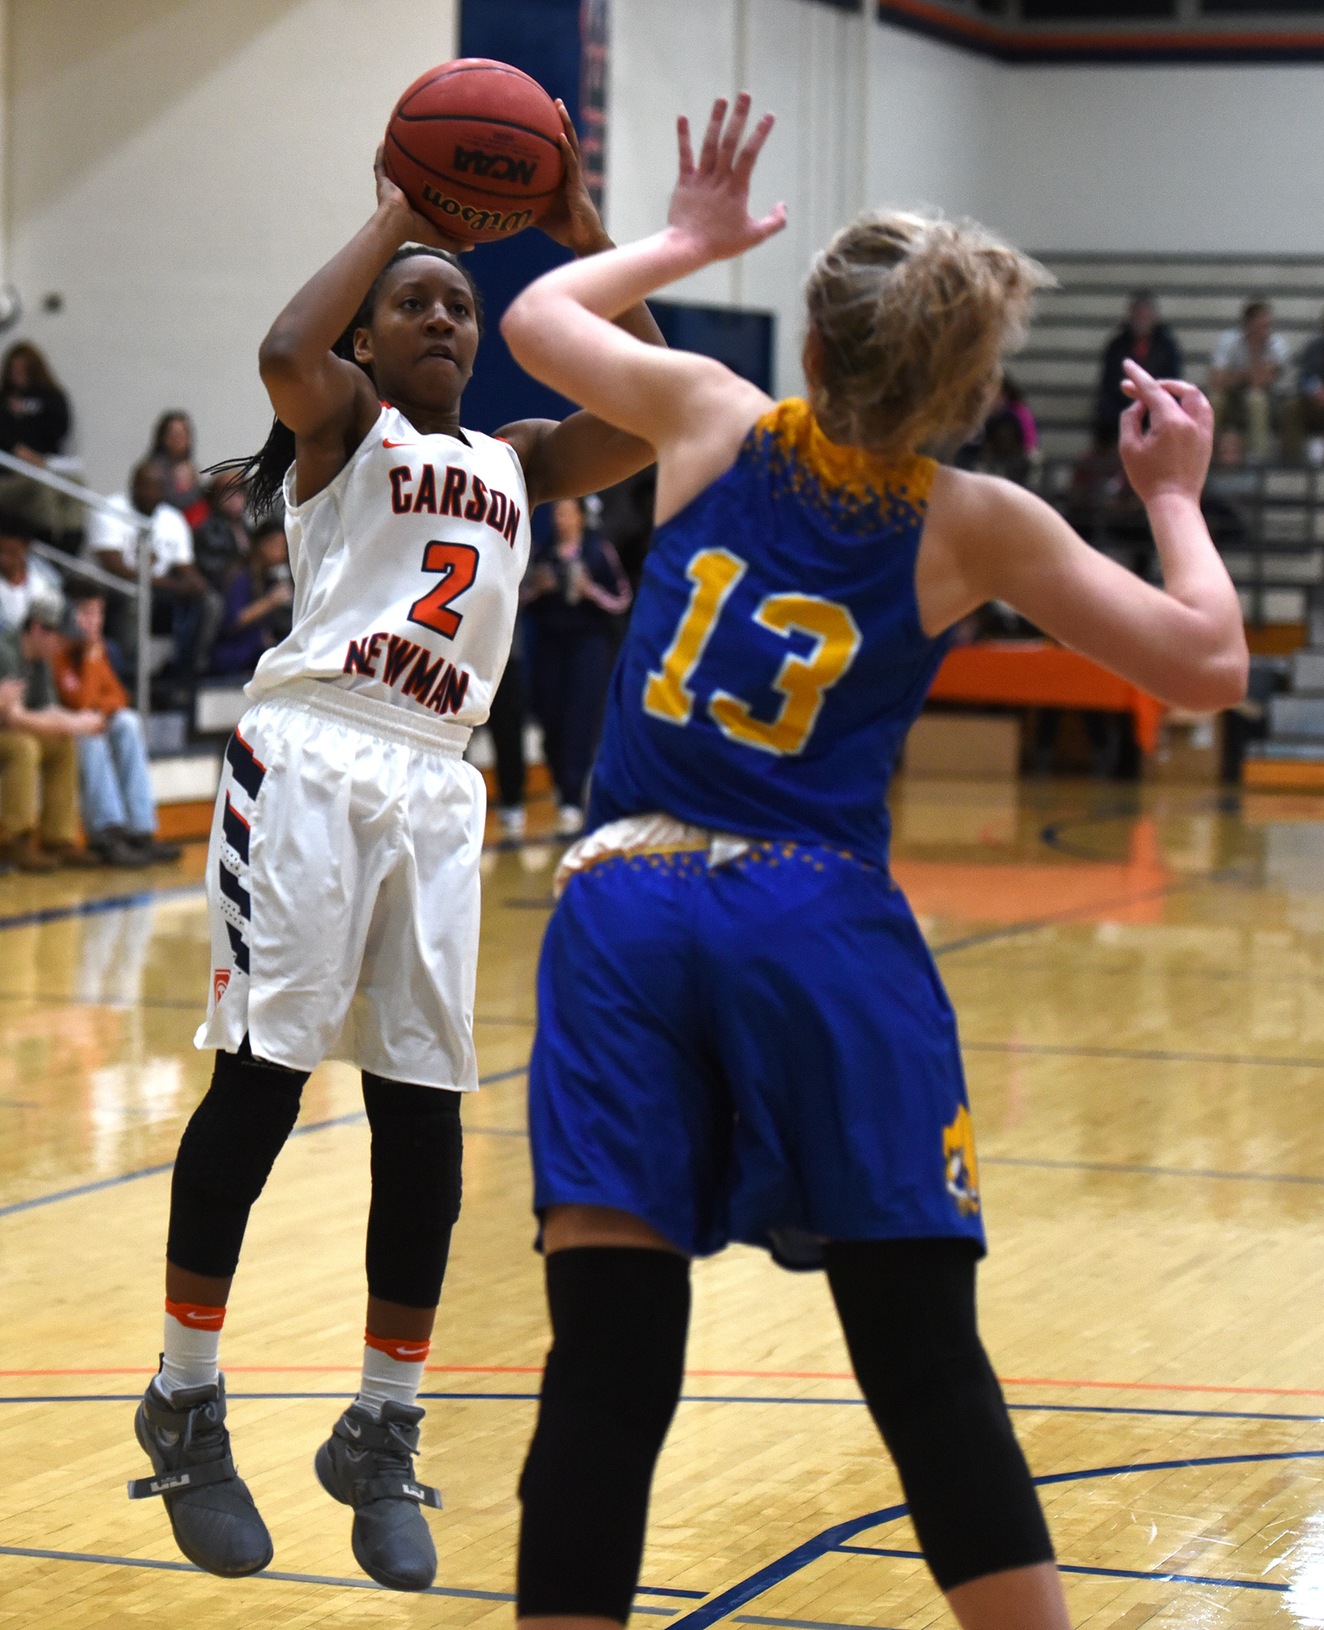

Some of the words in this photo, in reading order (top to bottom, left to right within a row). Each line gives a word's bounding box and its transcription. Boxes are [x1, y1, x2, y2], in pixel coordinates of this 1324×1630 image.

[423, 180, 533, 231] Wilson
[453, 146, 538, 186] NCAA
[389, 464, 520, 549] CARSON
[407, 540, 479, 641] 2
[343, 632, 469, 714] NEWMAN
[642, 547, 863, 756] 13
